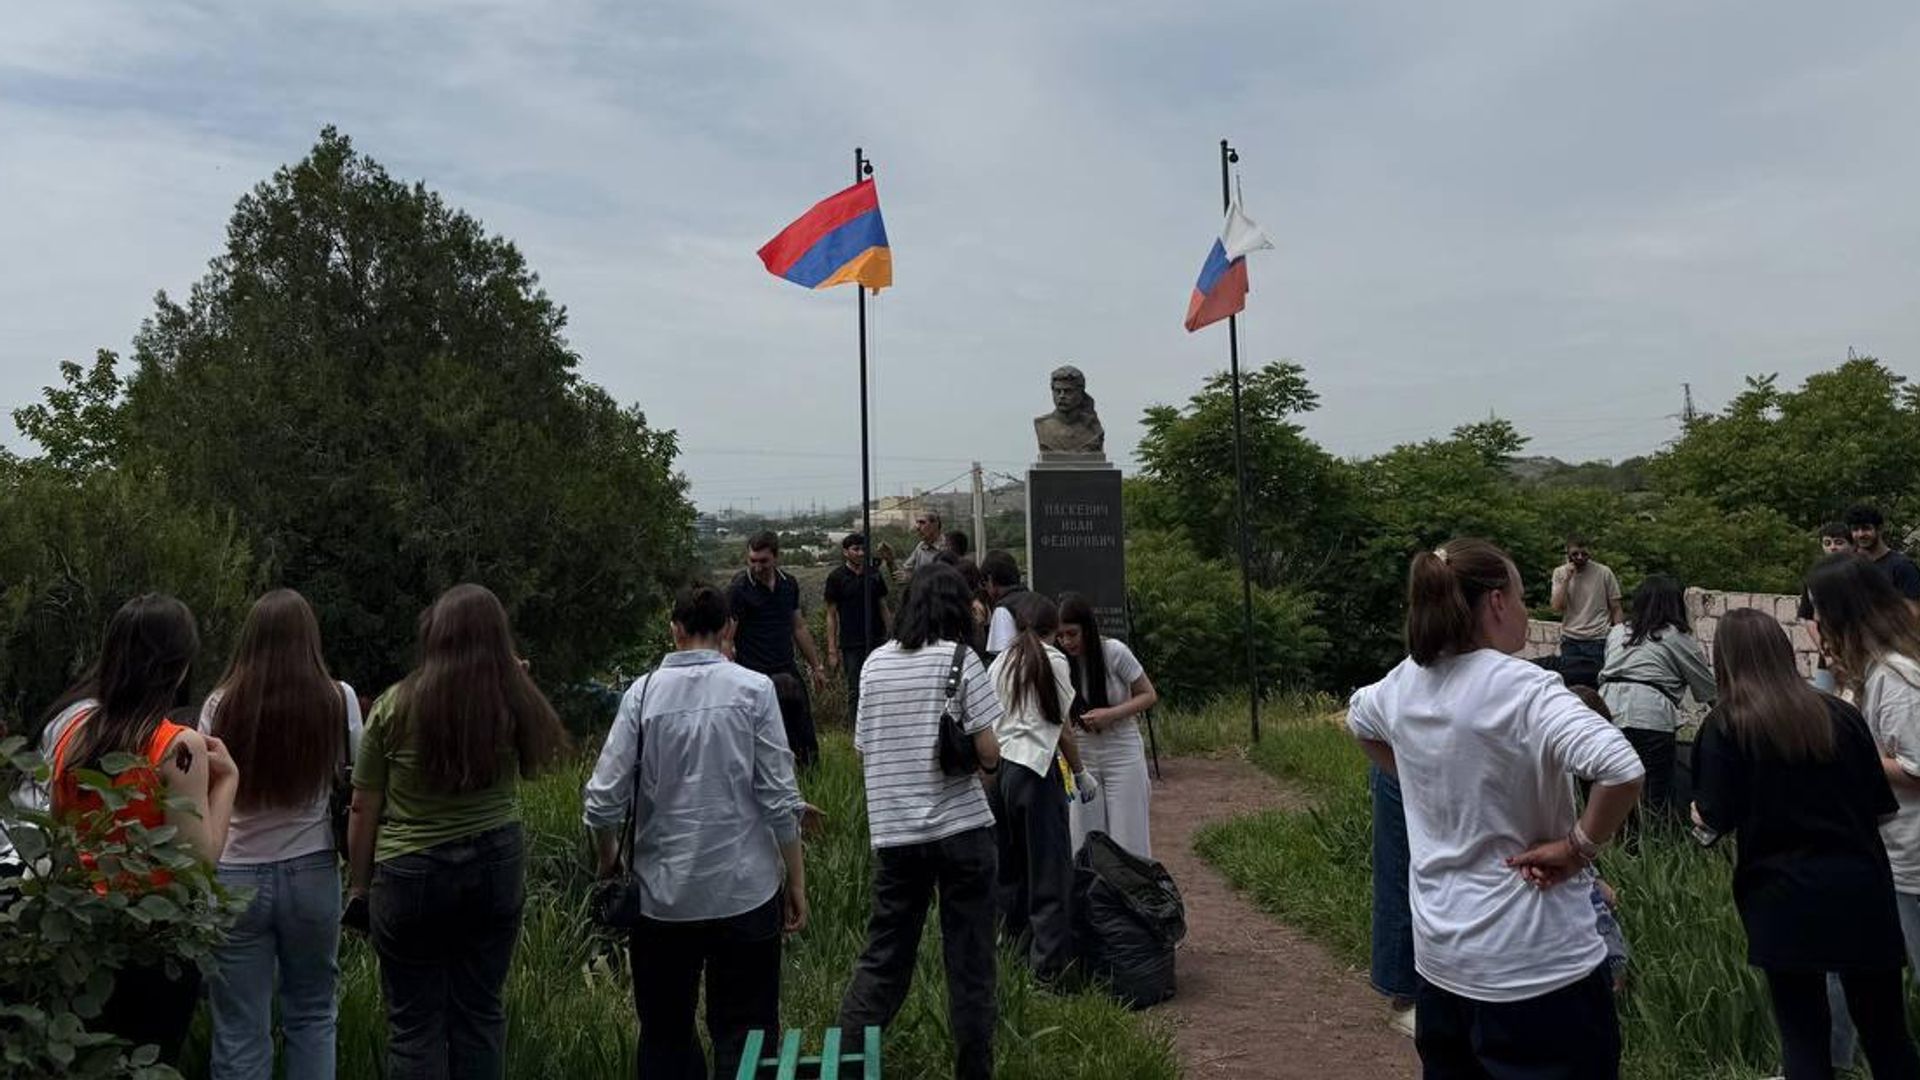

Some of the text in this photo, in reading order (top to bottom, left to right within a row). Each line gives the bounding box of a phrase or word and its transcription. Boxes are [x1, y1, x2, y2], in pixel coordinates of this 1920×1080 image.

[1043, 504, 1109, 517] ПАСКЕВИЧ
[1061, 519, 1093, 531] ИВАН
[1040, 535, 1116, 547] ФЕДОРОВИЧ
